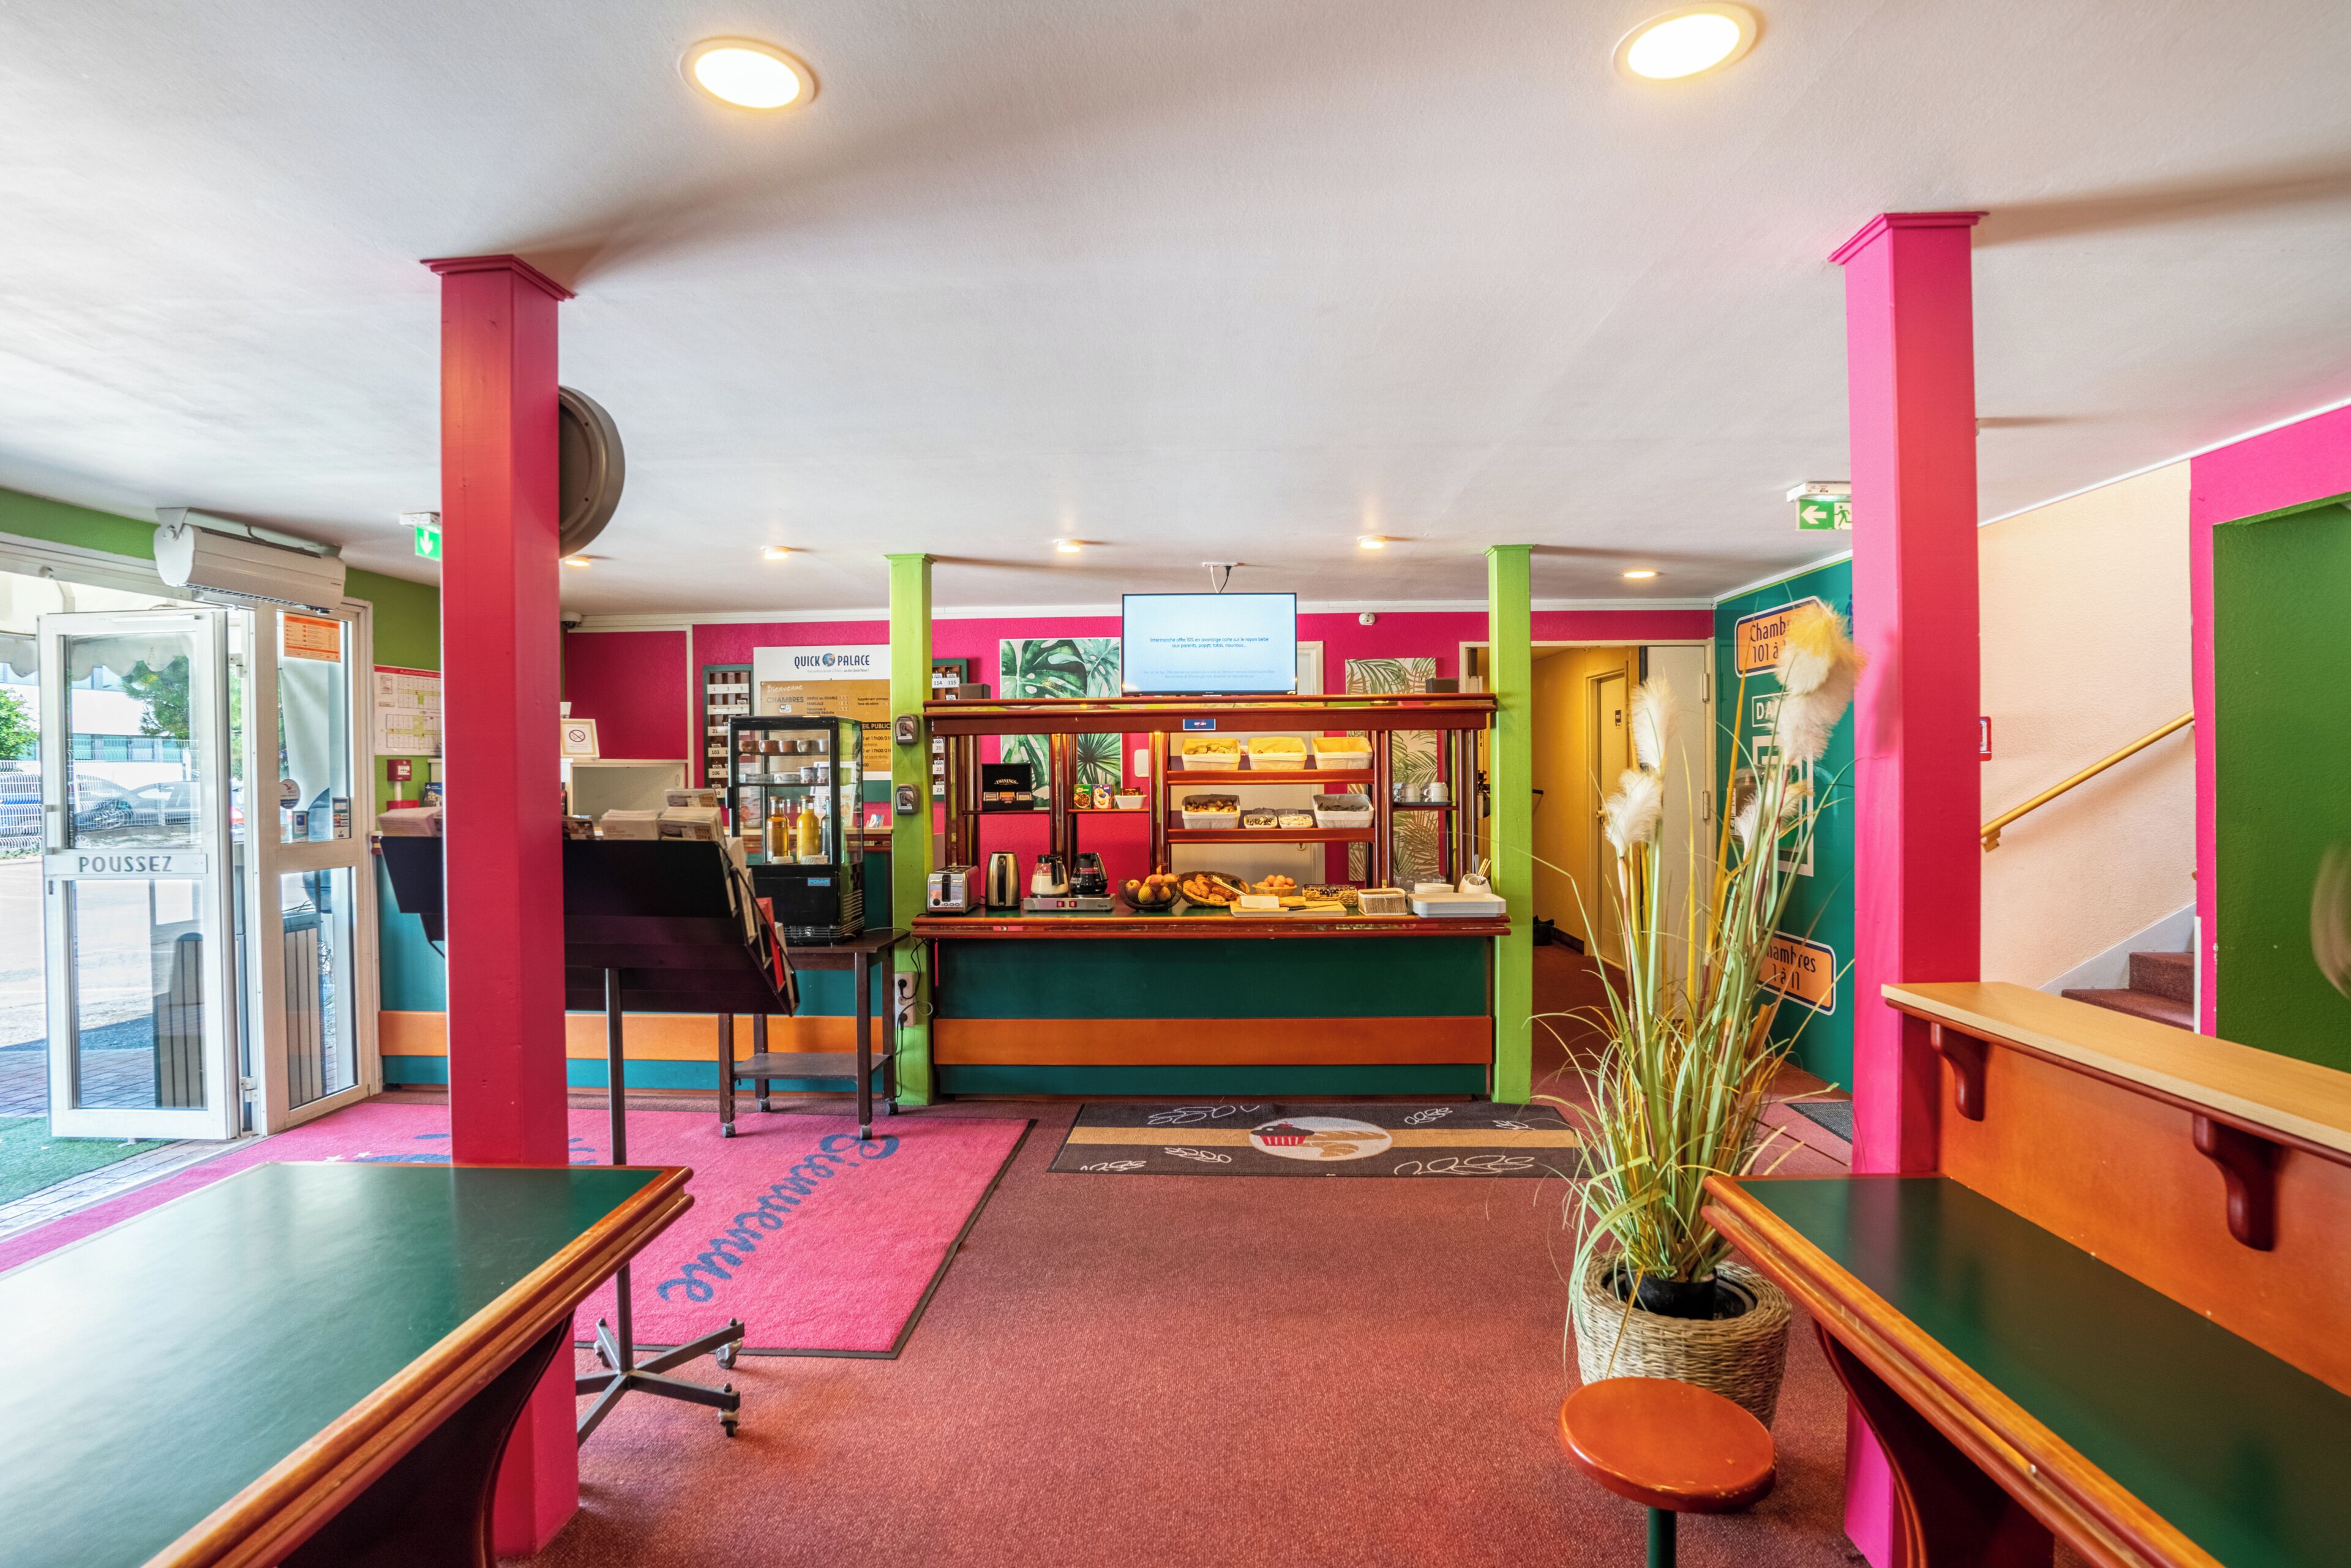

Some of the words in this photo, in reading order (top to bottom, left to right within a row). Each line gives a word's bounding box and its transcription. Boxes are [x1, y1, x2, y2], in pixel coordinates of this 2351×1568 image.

[1750, 616, 1791, 642] Chamb
[794, 656, 820, 669] QUICK
[838, 655, 870, 666] PALACE
[1752, 643, 1769, 663] 101
[1772, 642, 1779, 659] à
[767, 685, 804, 693] Bienvenue
[78, 856, 172, 872] POUSSEZ
[1766, 945, 1816, 973] hambres
[656, 1133, 900, 1302] Bienvenue
